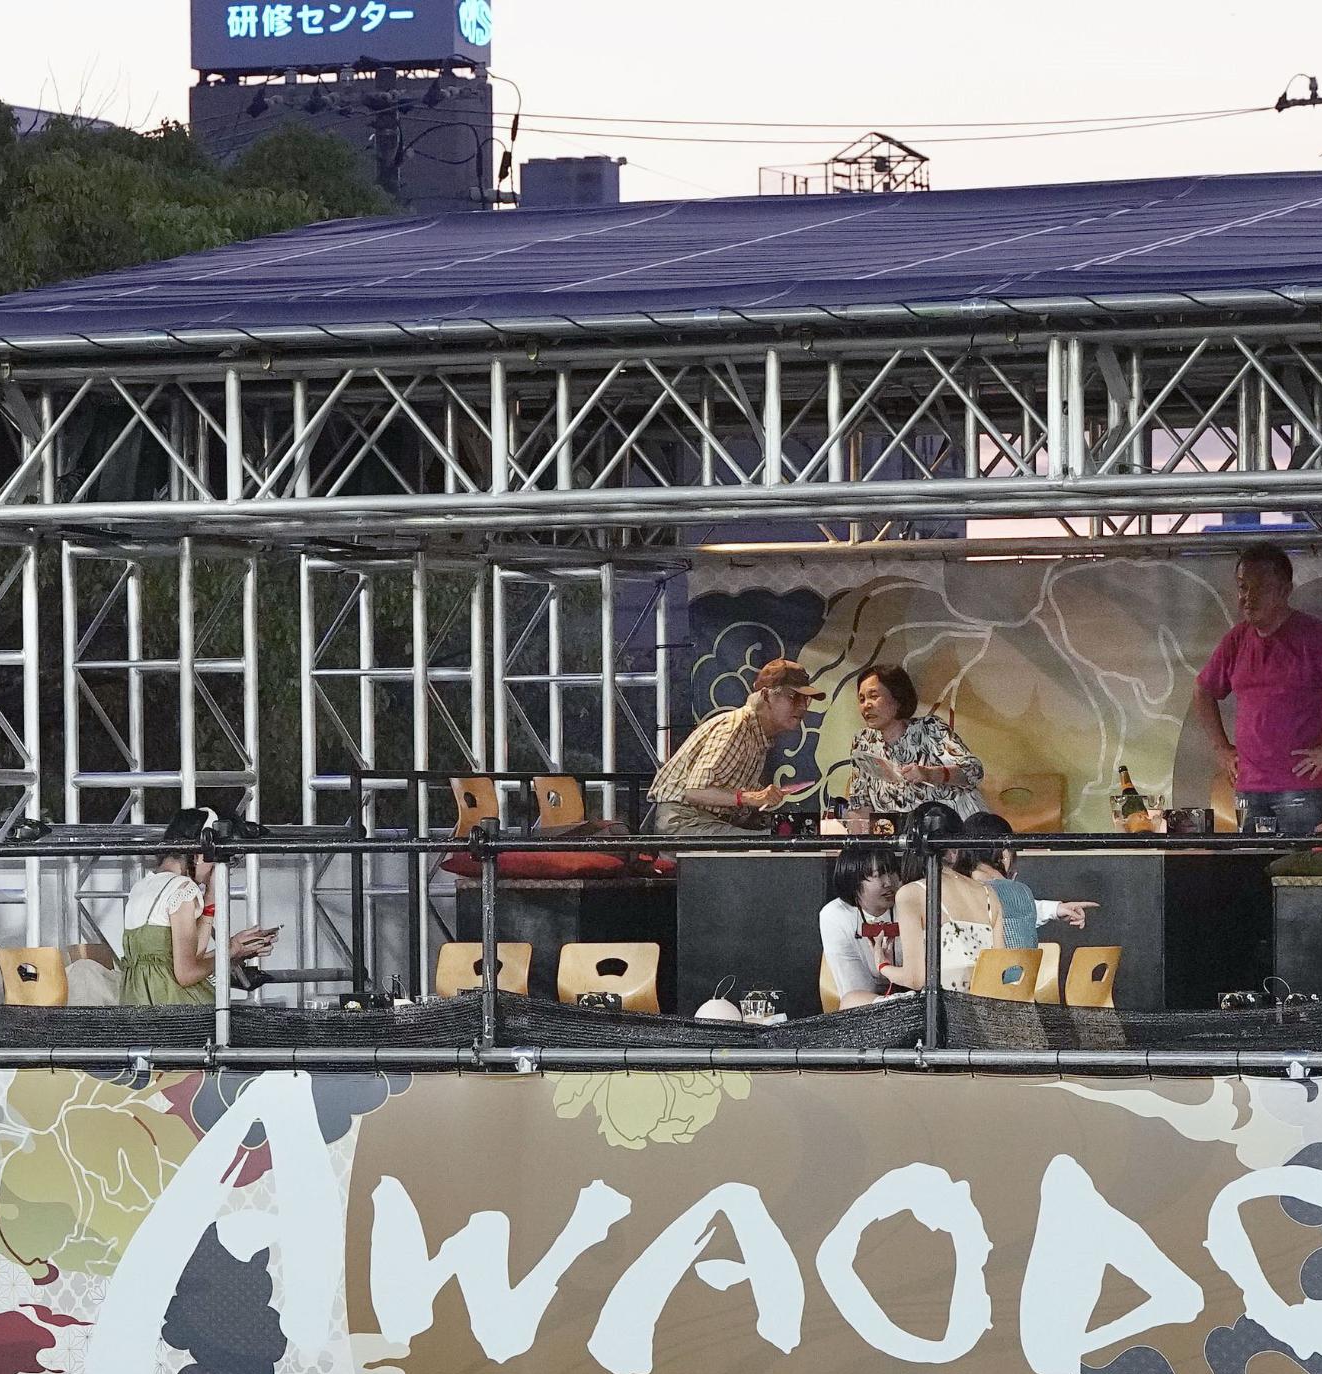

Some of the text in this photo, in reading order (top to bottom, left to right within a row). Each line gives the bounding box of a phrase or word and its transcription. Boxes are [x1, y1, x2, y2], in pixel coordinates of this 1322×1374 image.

[227, 2, 415, 37] 研修センター
